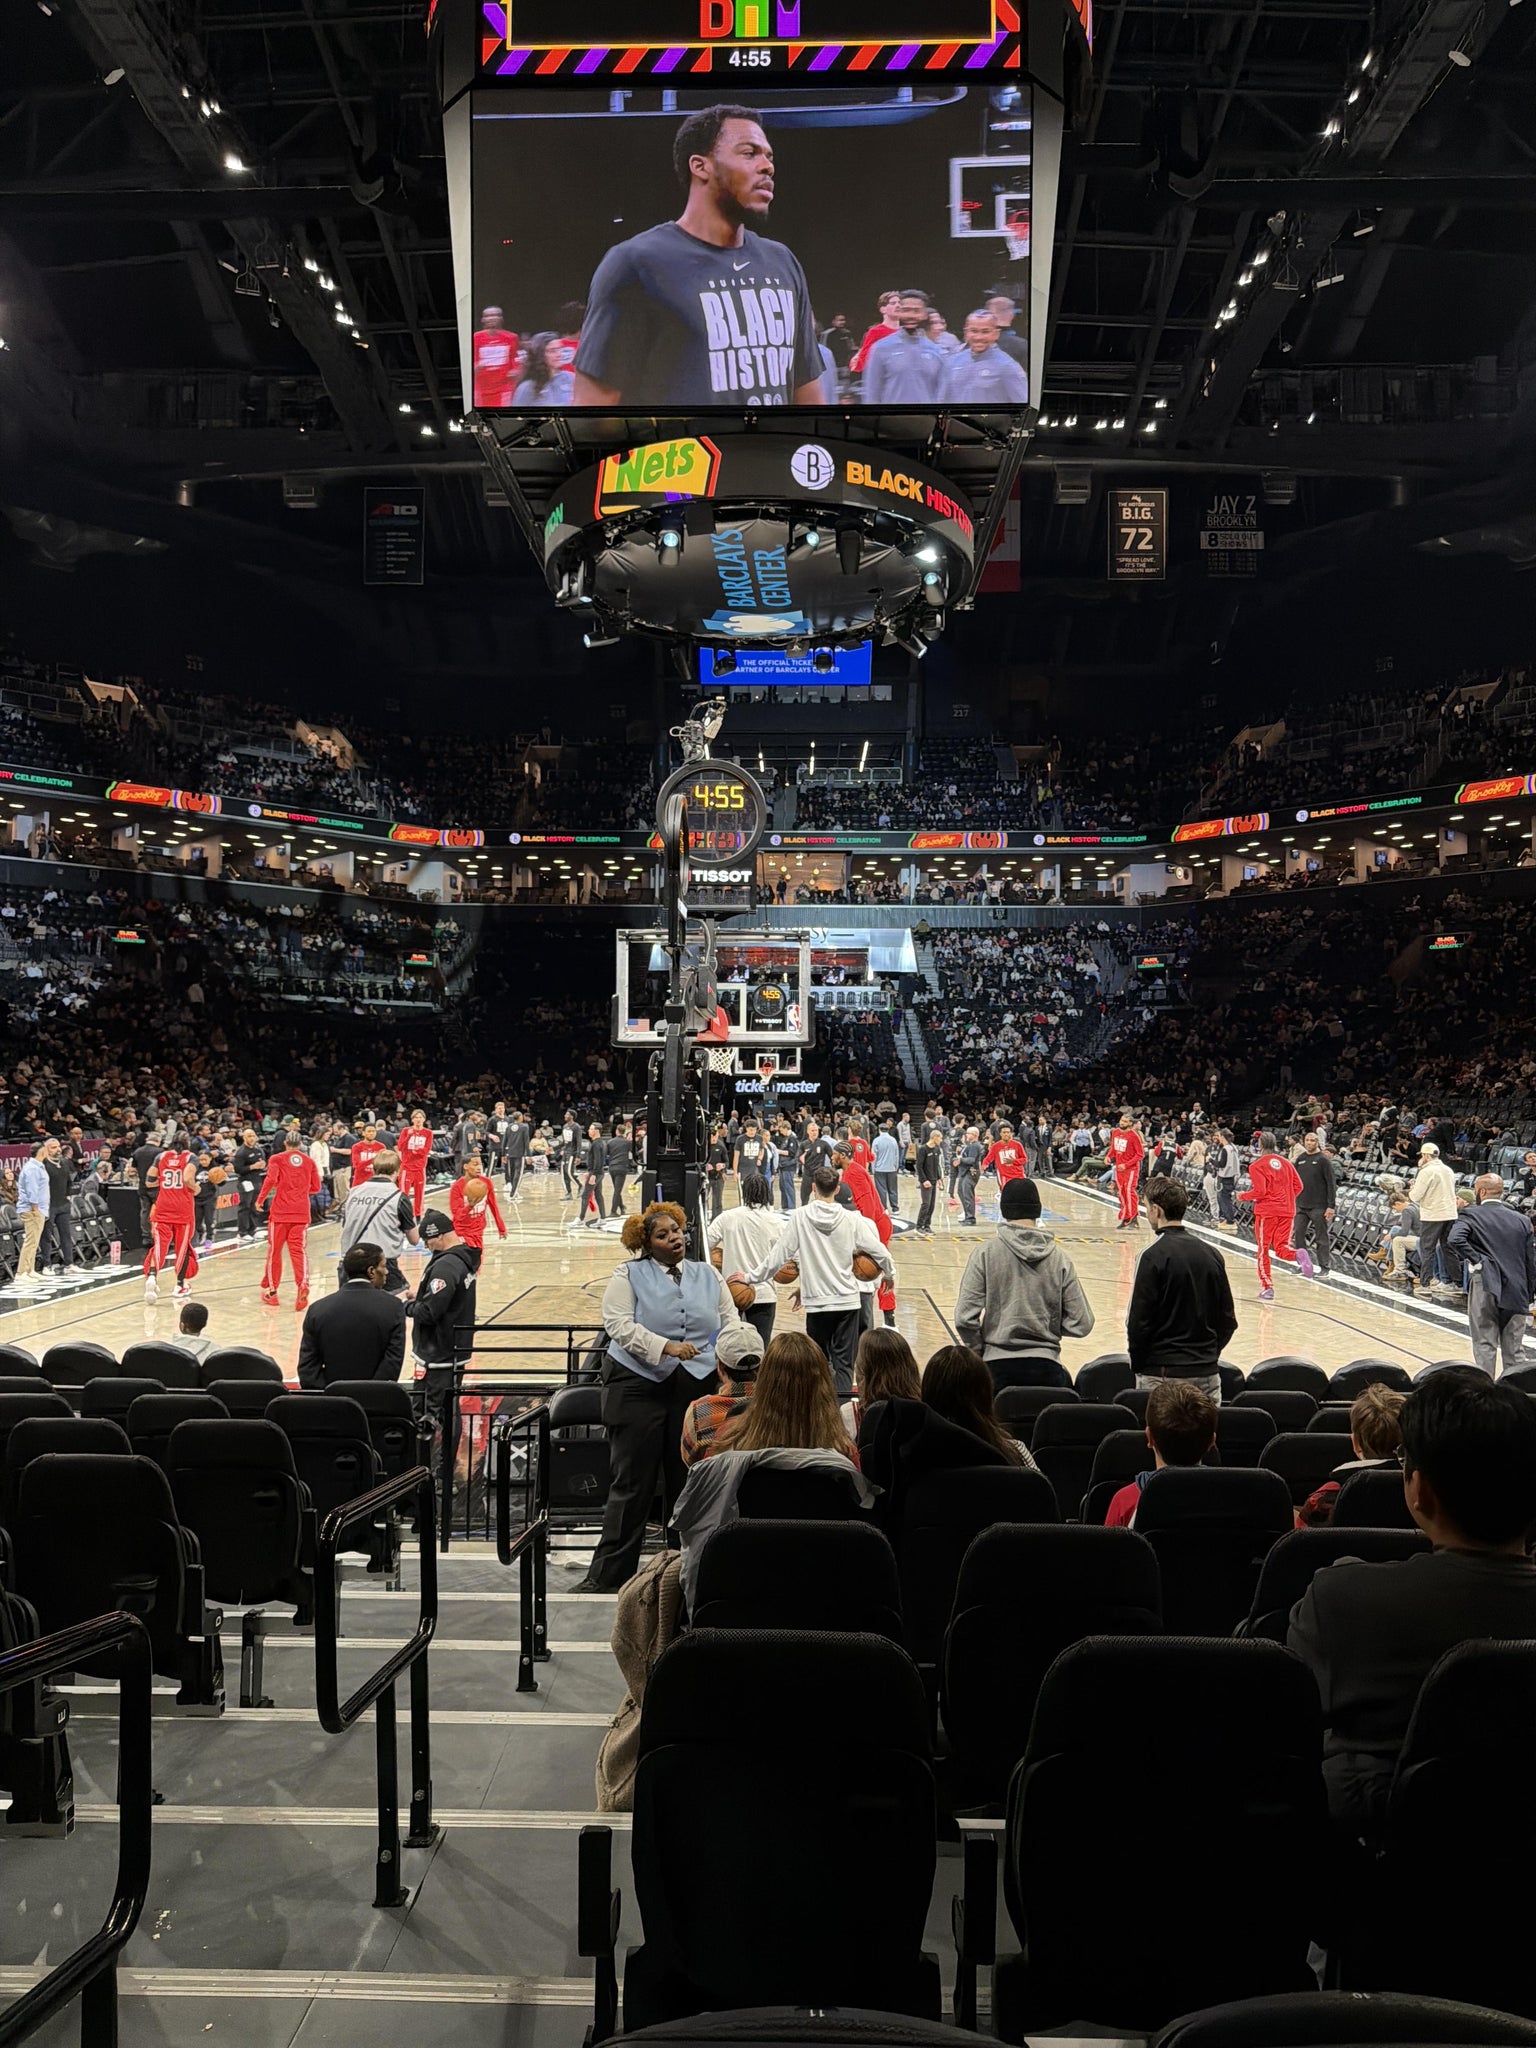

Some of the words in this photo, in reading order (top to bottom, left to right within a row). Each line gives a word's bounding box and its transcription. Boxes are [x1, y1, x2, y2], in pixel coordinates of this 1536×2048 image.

[728, 50, 771, 67] 4:55
[615, 442, 696, 492] Nets
[846, 460, 924, 503] BLACK
[1122, 507, 1154, 520] B.I.G.
[1207, 495, 1241, 514] JAY
[1244, 495, 1256, 514] Z
[1207, 515, 1257, 527] BROOKLYN
[1120, 527, 1154, 550] 72
[1208, 532, 1219, 548] 8
[711, 529, 758, 607] BARCLAYS
[753, 545, 793, 607] CENTER
[14, 774, 73, 788] CELEBRATION
[694, 785, 745, 808] 4:55
[263, 808, 288, 819] BLACK
[1310, 808, 1336, 818] BLACK
[1336, 803, 1369, 815] HISTORY
[1369, 796, 1422, 810] CELEBRATION
[522, 835, 546, 843] BLACK
[691, 870, 752, 883] TISSOT
[162, 1168, 183, 1189] 31
